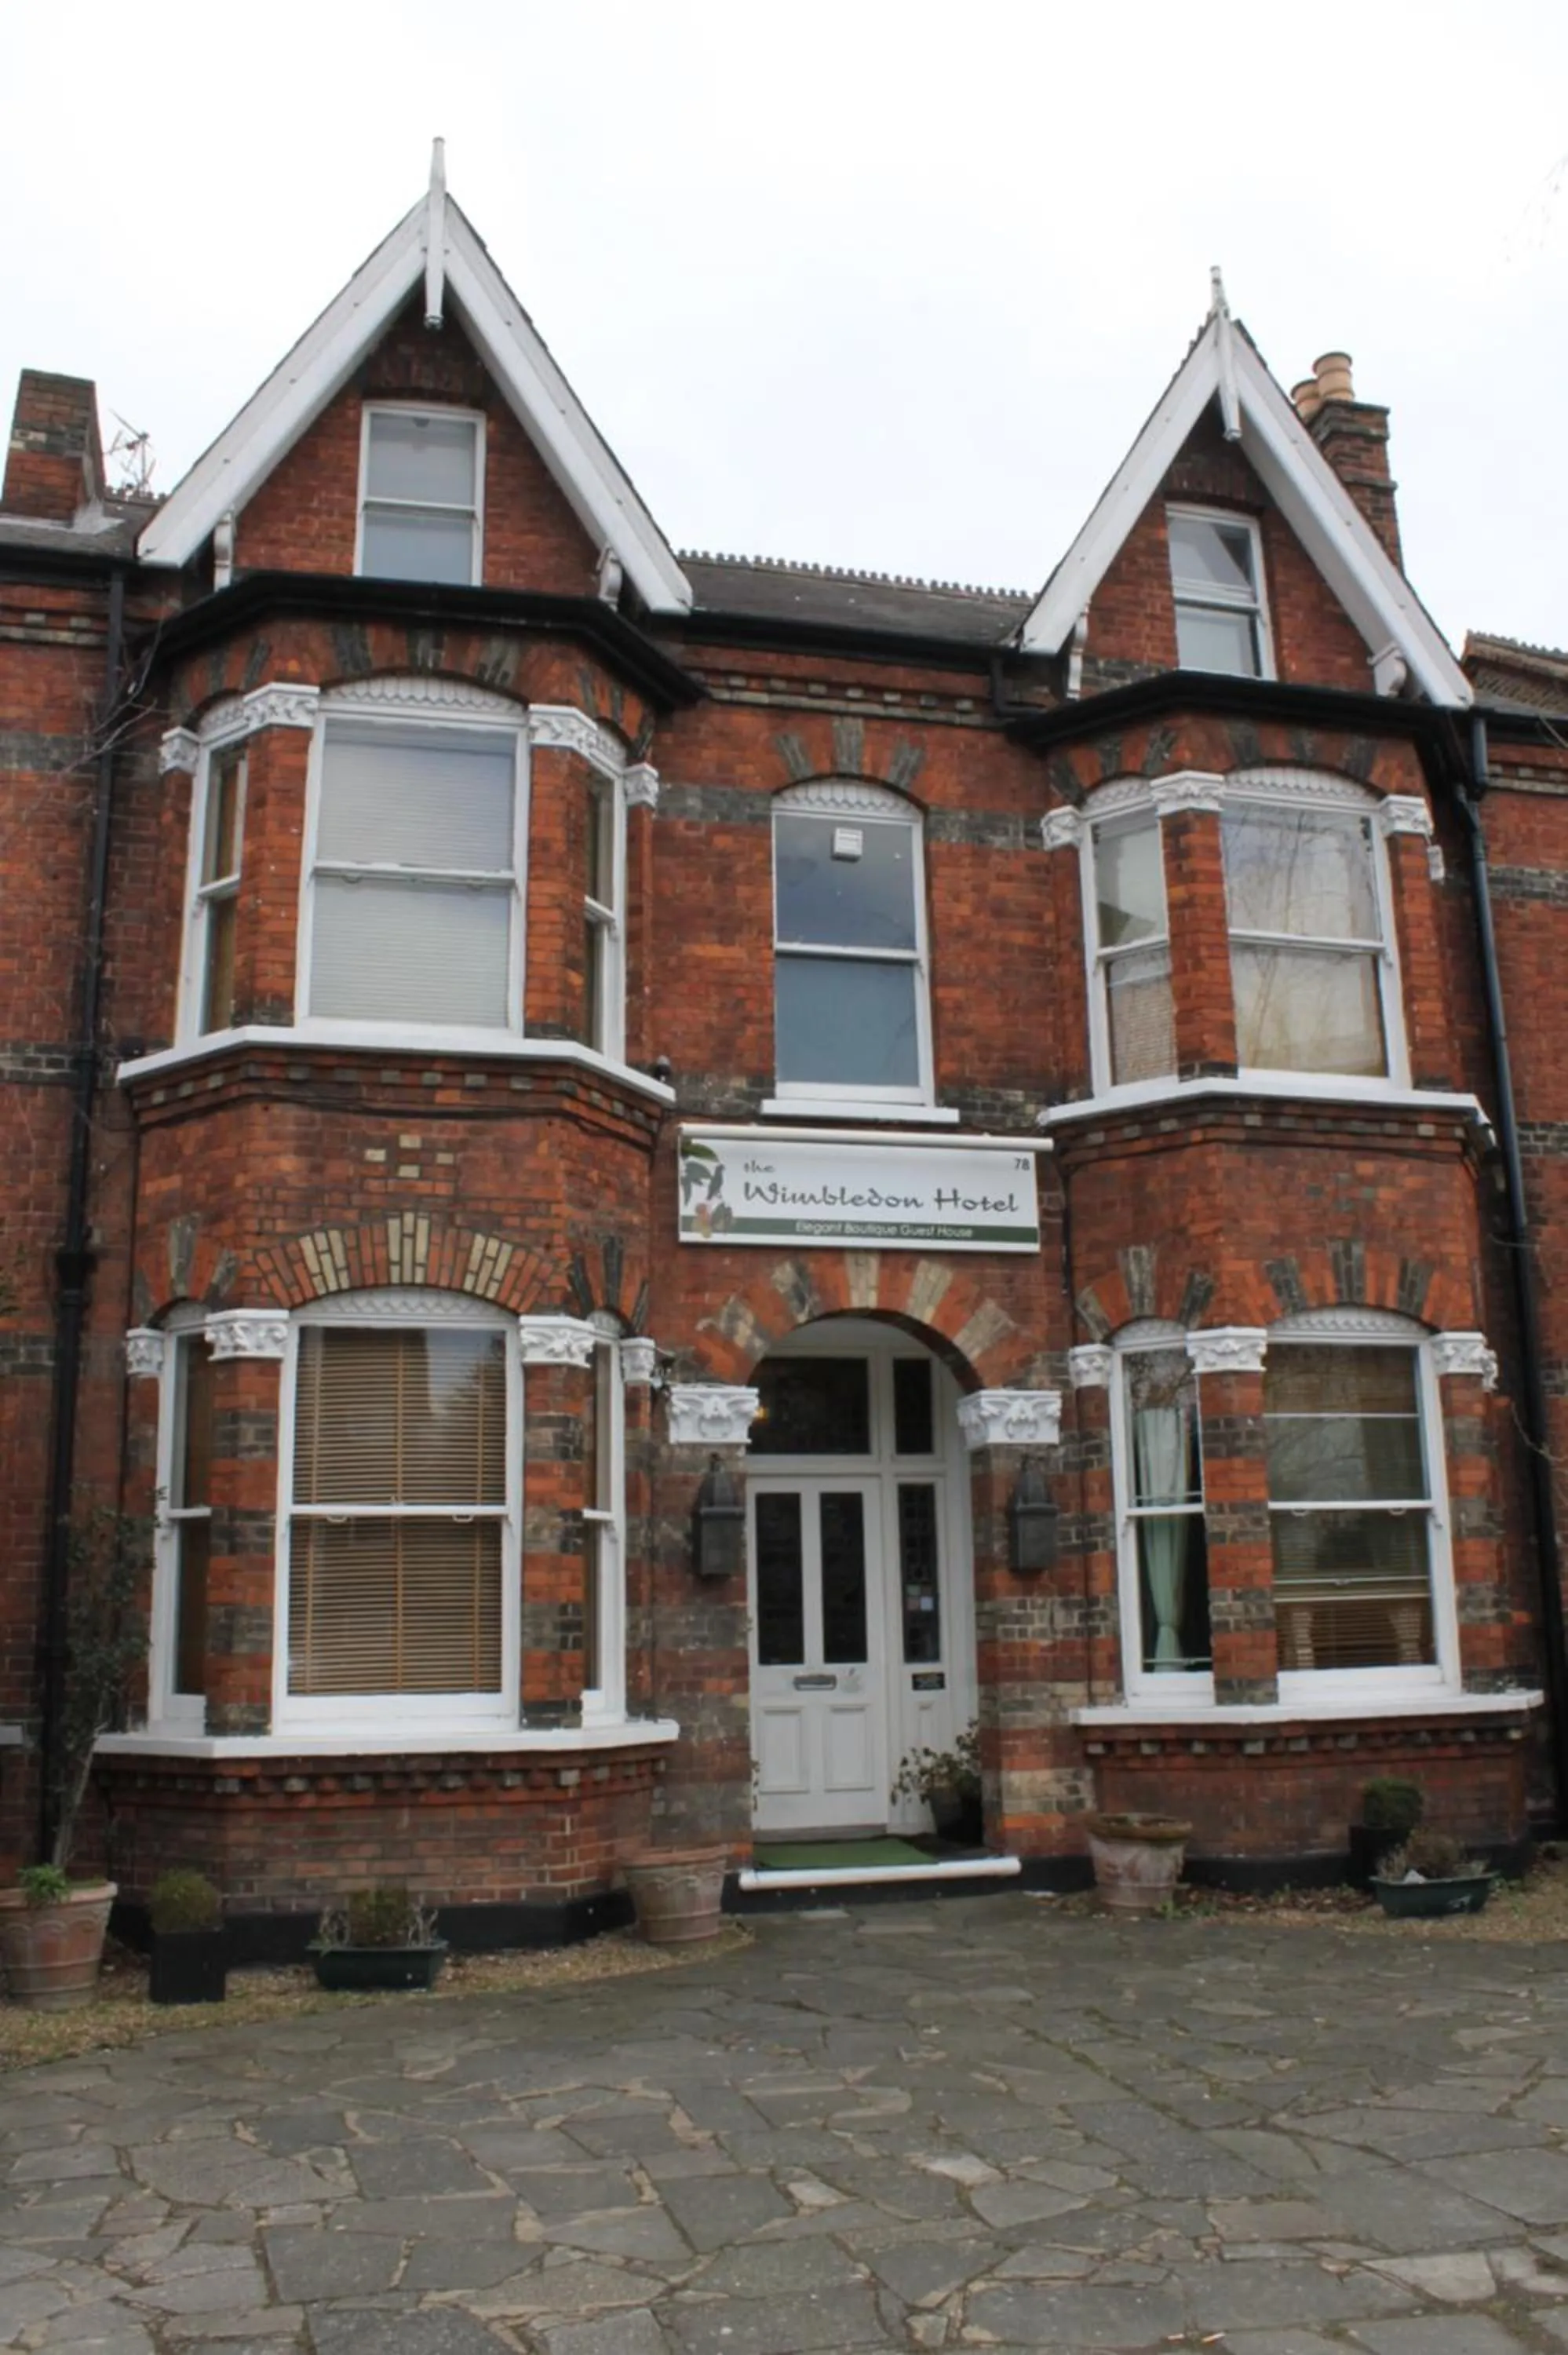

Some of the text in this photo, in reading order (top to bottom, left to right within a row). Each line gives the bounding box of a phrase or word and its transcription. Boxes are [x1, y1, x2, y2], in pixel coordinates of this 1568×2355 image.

[743, 1159, 776, 1174] the
[1014, 1158, 1030, 1170] 78
[744, 1181, 1019, 1213] Wimbledon Hotel
[795, 1221, 974, 1238] Elegant Boutique Guest House
